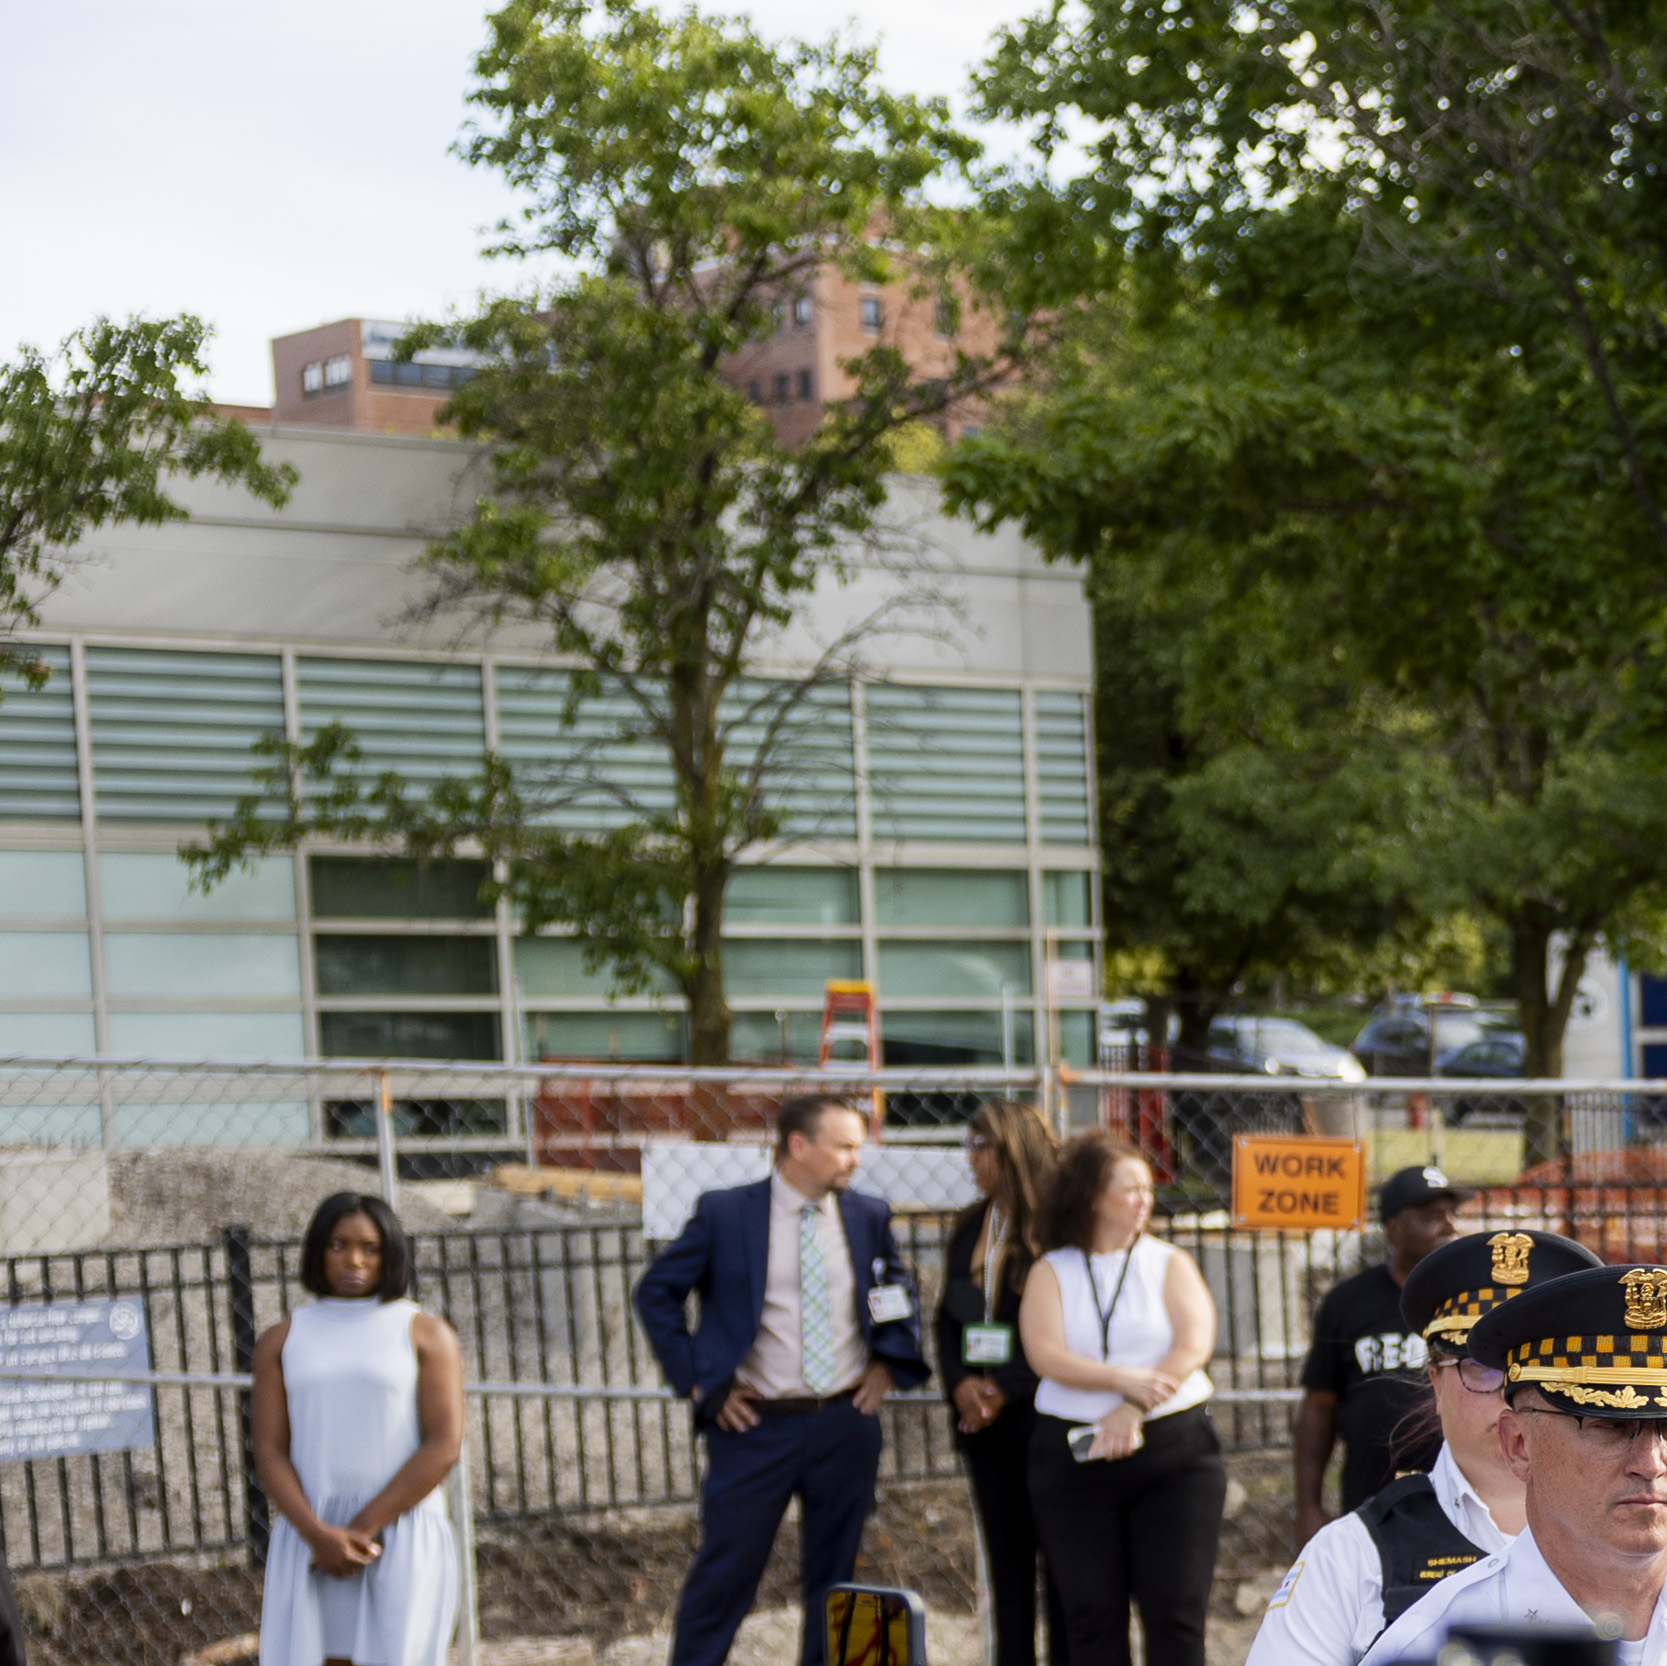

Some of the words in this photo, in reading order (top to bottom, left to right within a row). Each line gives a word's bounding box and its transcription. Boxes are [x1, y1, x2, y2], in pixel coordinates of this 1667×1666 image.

[1254, 1154, 1346, 1179] WORK
[1257, 1189, 1339, 1215] ZONE
[1427, 1555, 1477, 1567] SHEMASH
